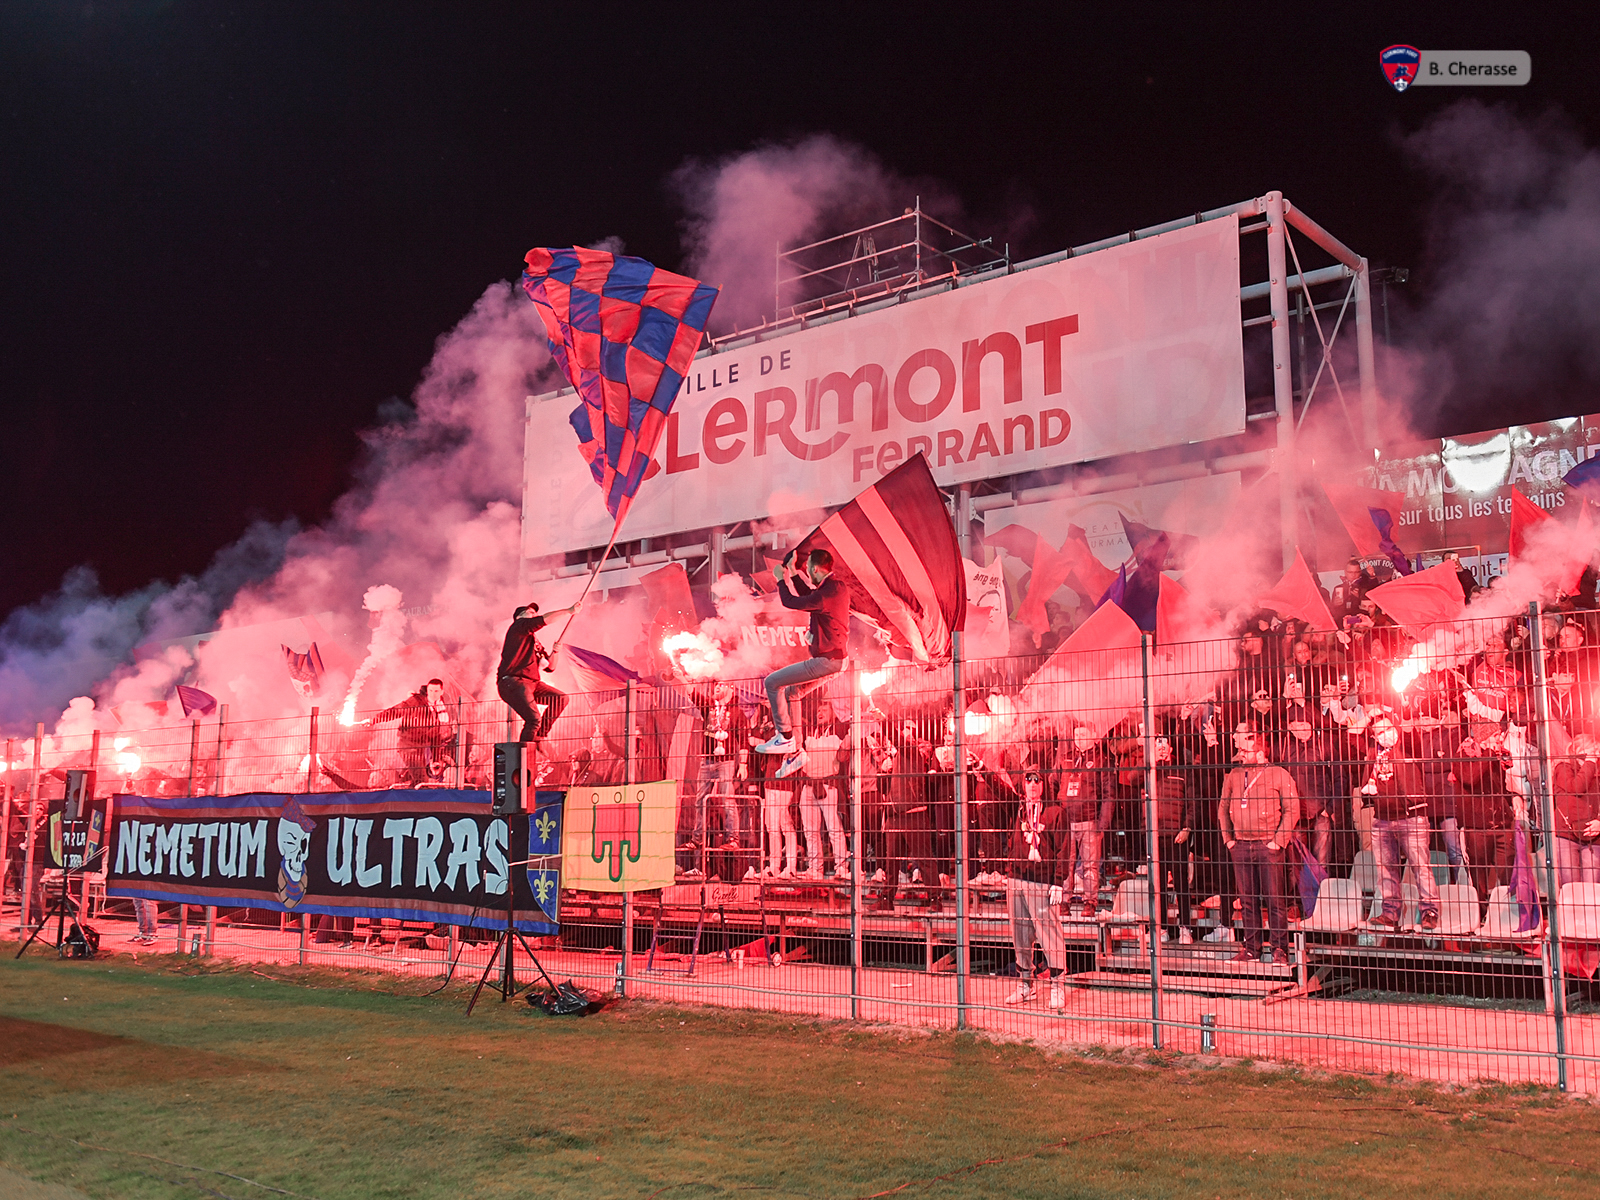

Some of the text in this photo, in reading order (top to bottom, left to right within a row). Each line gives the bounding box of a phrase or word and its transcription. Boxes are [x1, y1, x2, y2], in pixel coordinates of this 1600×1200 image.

[686, 350, 791, 394] ILLE DE
[1398, 489, 1566, 526] sur tous les teains
[740, 625, 812, 647] NEMET
[114, 815, 511, 895] NEMETUM ULTRAS
